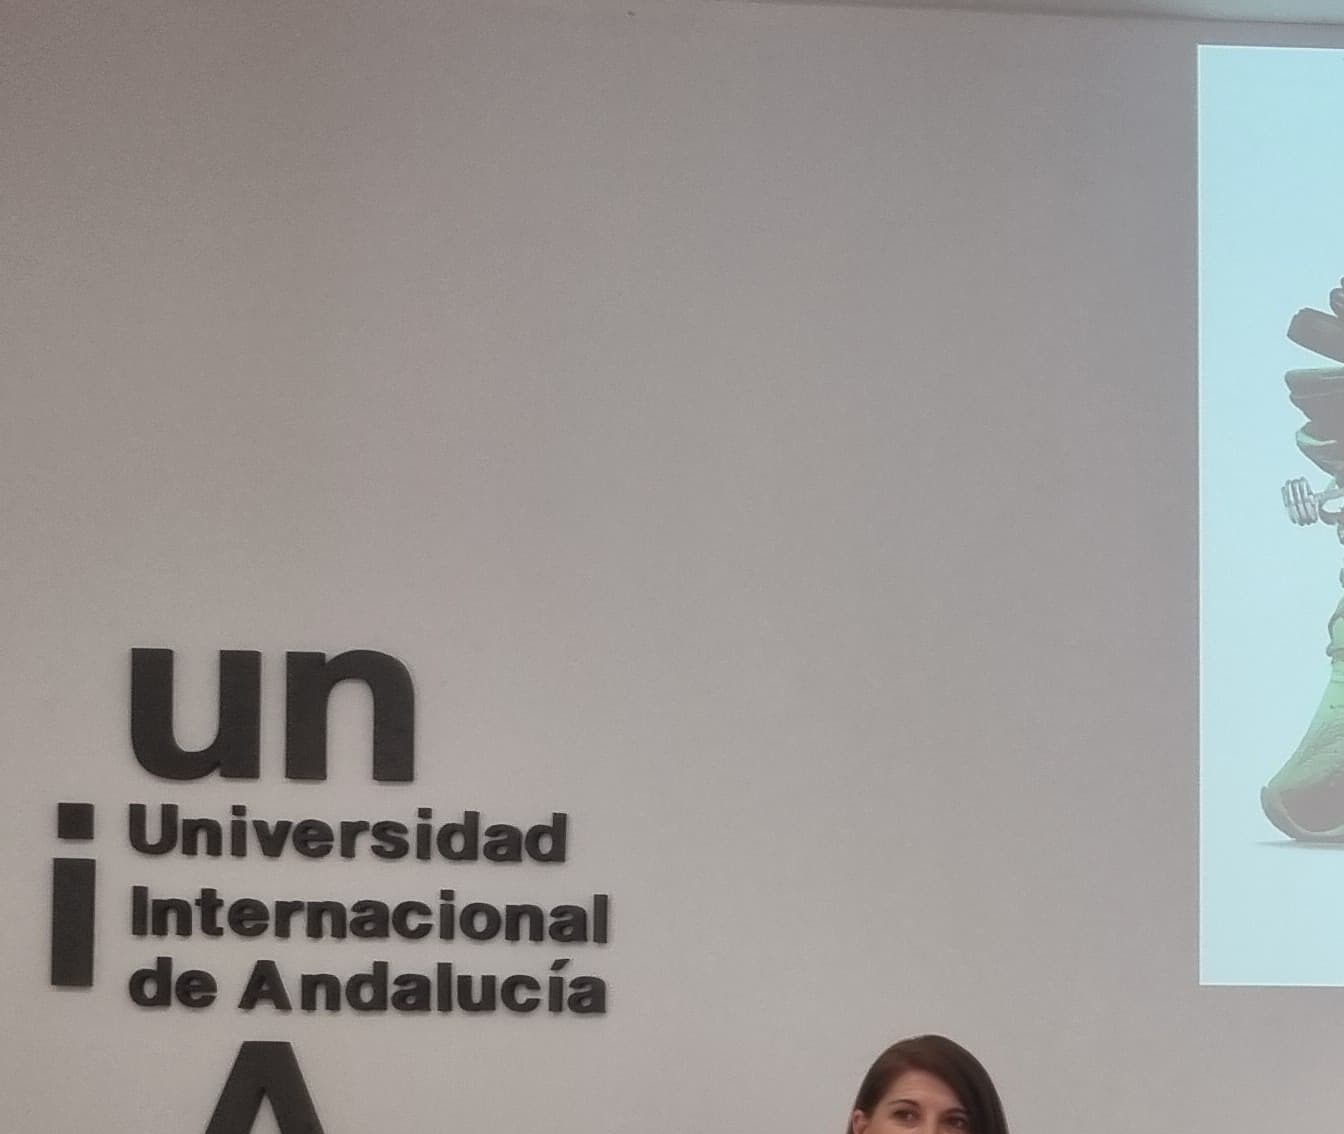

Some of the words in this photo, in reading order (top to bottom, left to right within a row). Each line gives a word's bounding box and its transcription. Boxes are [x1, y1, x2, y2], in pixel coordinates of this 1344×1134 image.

[130, 647, 415, 782] un
[128, 802, 568, 863] Universidad
[51, 802, 96, 987] i
[130, 885, 609, 944] Internacional
[128, 956, 218, 1008] de
[238, 957, 607, 1014] Andalucía
